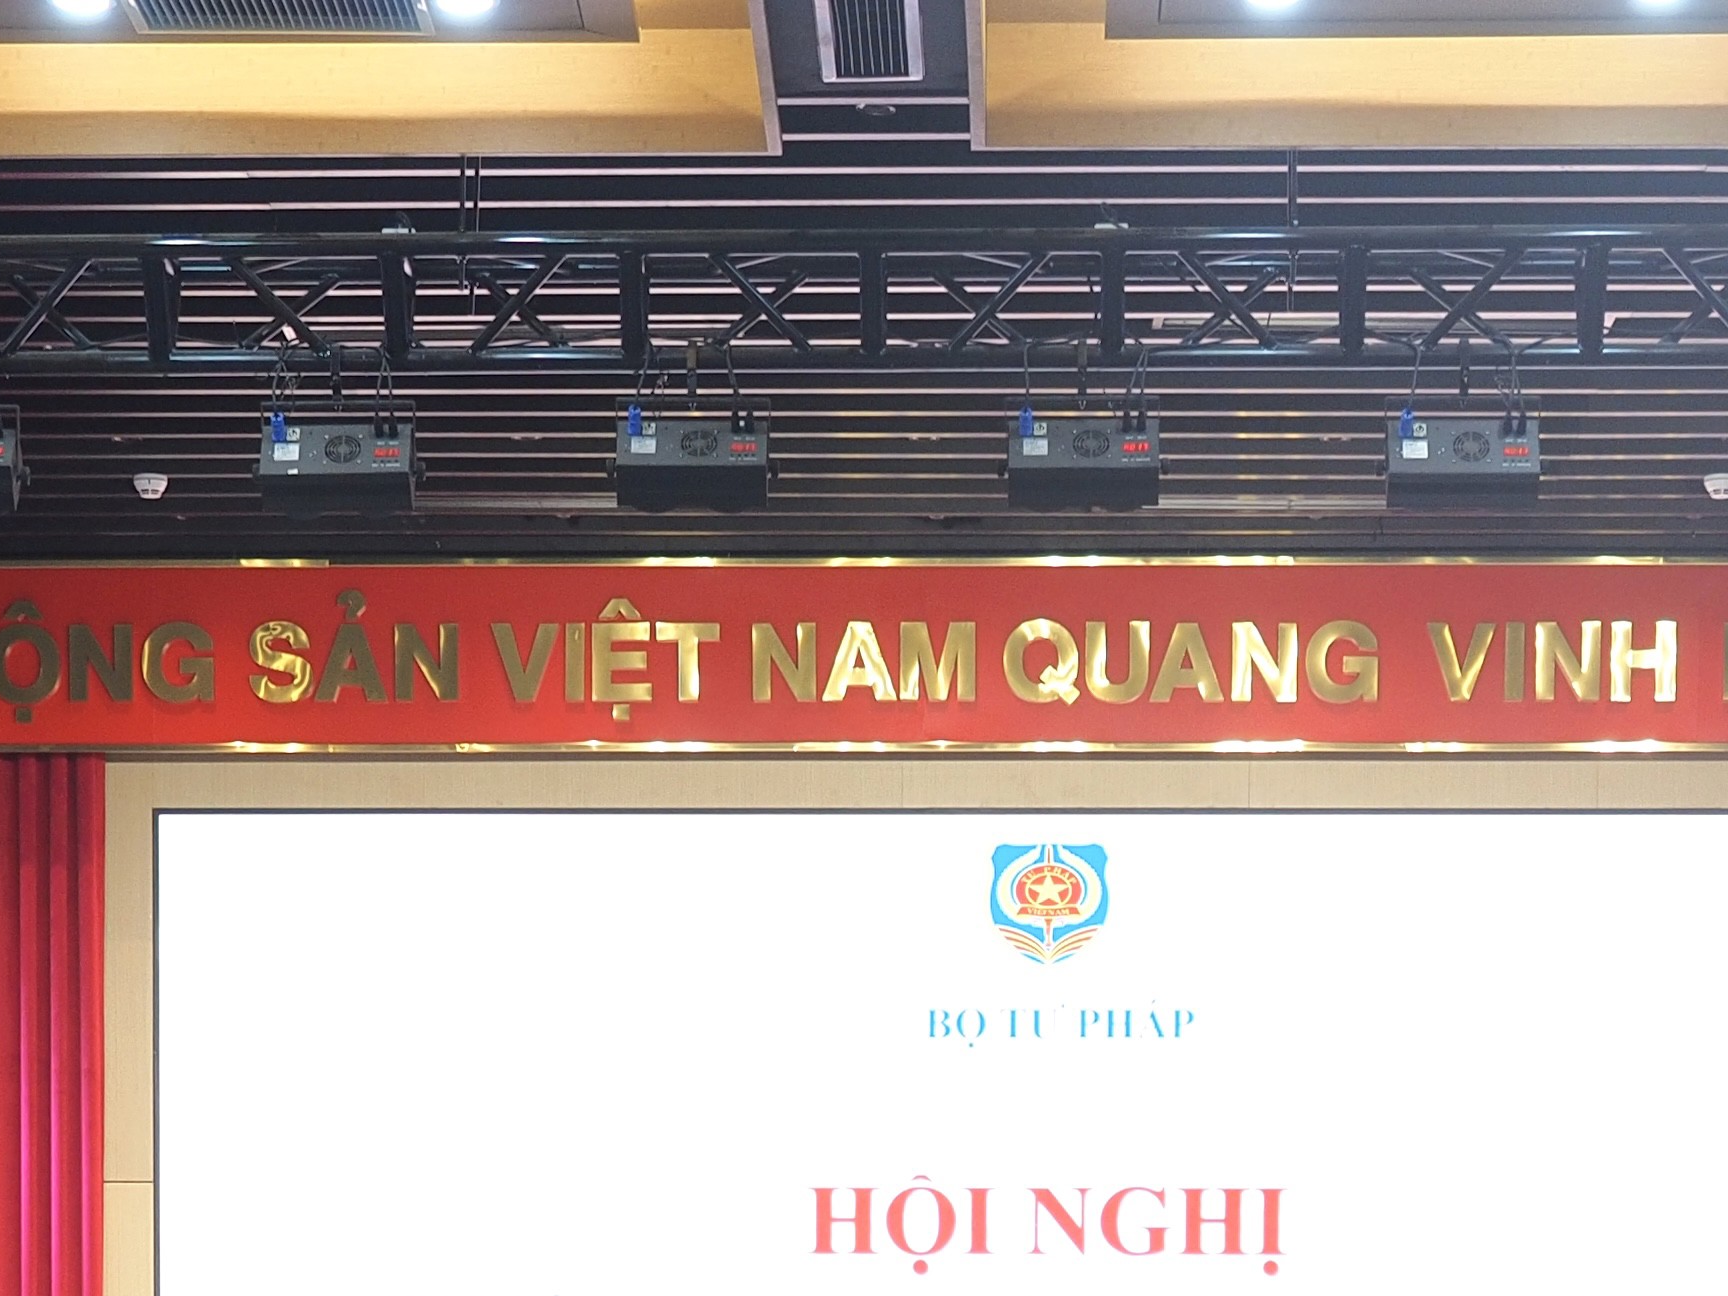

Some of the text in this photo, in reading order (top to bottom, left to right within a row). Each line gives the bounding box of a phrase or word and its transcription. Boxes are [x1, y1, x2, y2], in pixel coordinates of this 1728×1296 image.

[249, 589, 461, 706] SẢN
[489, 596, 720, 722] VIỆT
[749, 620, 976, 704] NAM
[1001, 617, 1381, 705] QUANG
[1426, 618, 1679, 704] VINH
[1079, 999, 1197, 1040] PHÁP
[807, 1174, 1288, 1277] HỘI NGHỊ
